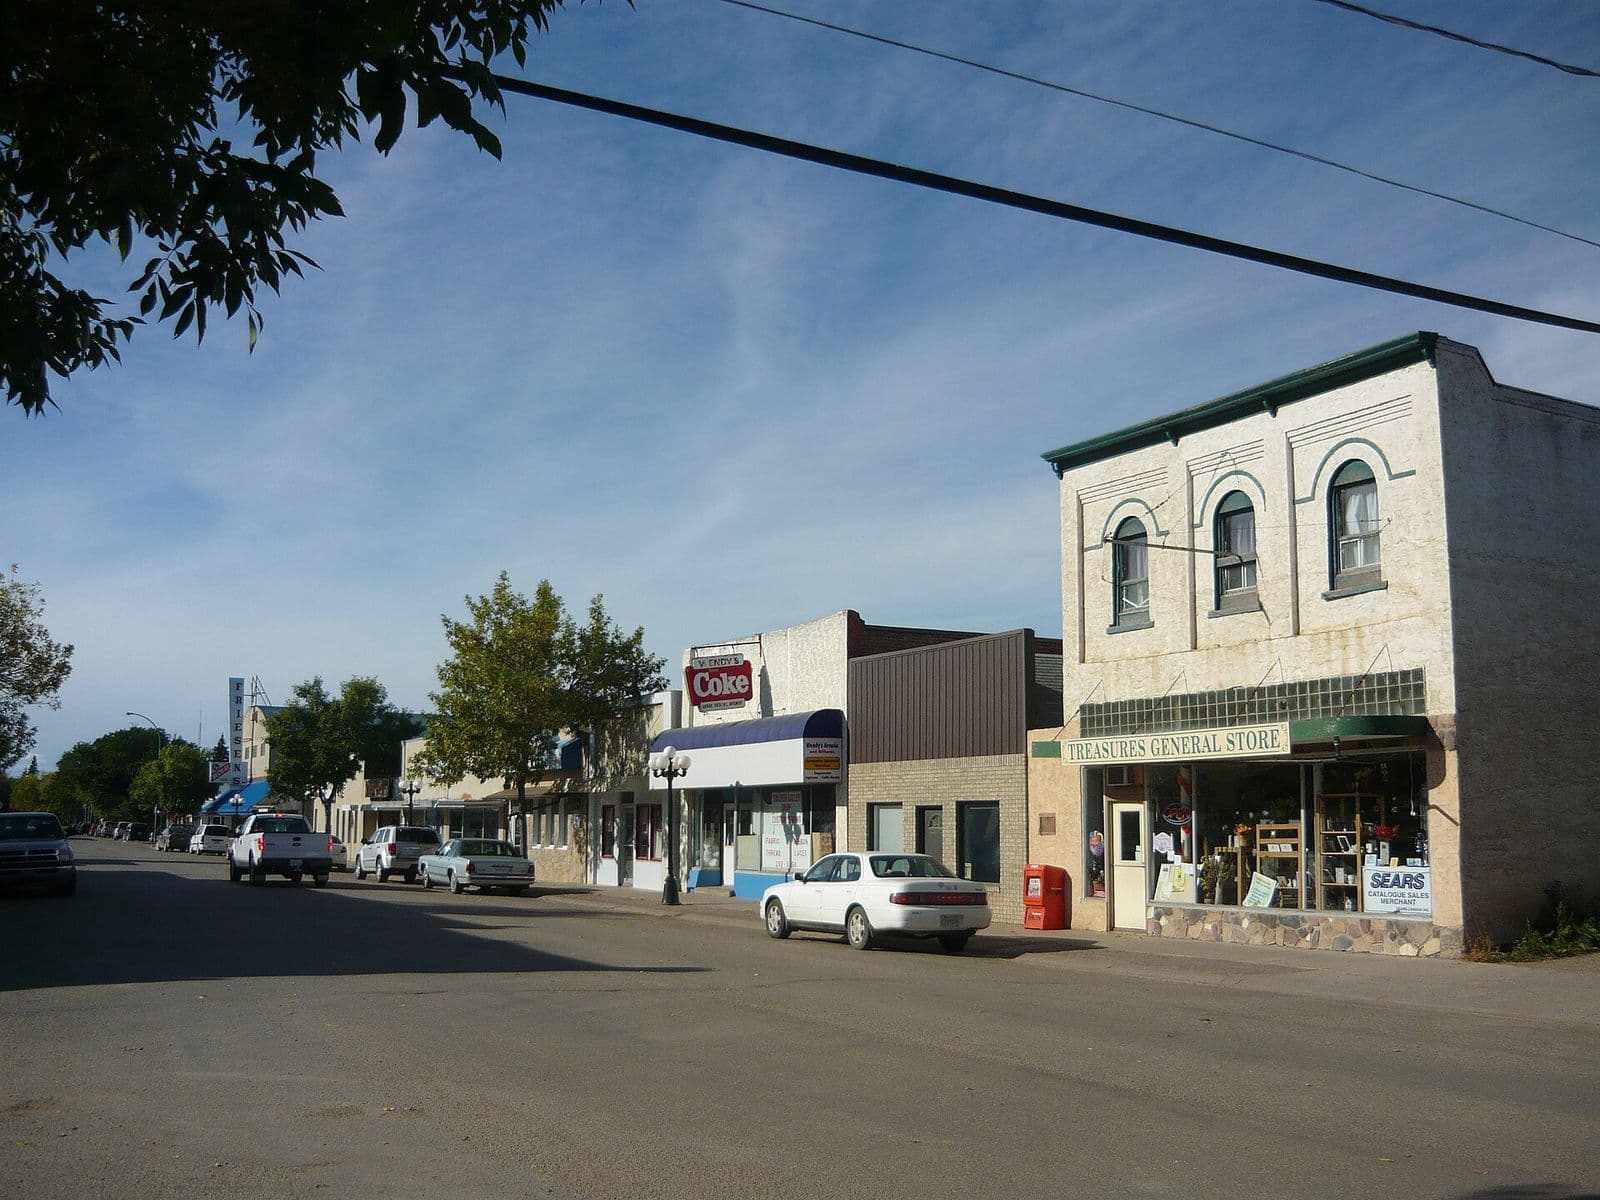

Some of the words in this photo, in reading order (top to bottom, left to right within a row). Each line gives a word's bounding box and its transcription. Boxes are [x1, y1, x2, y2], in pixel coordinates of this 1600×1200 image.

[693, 672, 750, 698] Coke
[233, 682, 242, 785] FRIESENS
[1068, 740, 1146, 761] TREASURES
[1151, 733, 1222, 756] GENERAL
[1226, 728, 1281, 751] STORE
[1370, 872, 1425, 890] SEARS
[1368, 890, 1406, 898] CATALOGUE
[1380, 898, 1417, 906] MERCHANT
